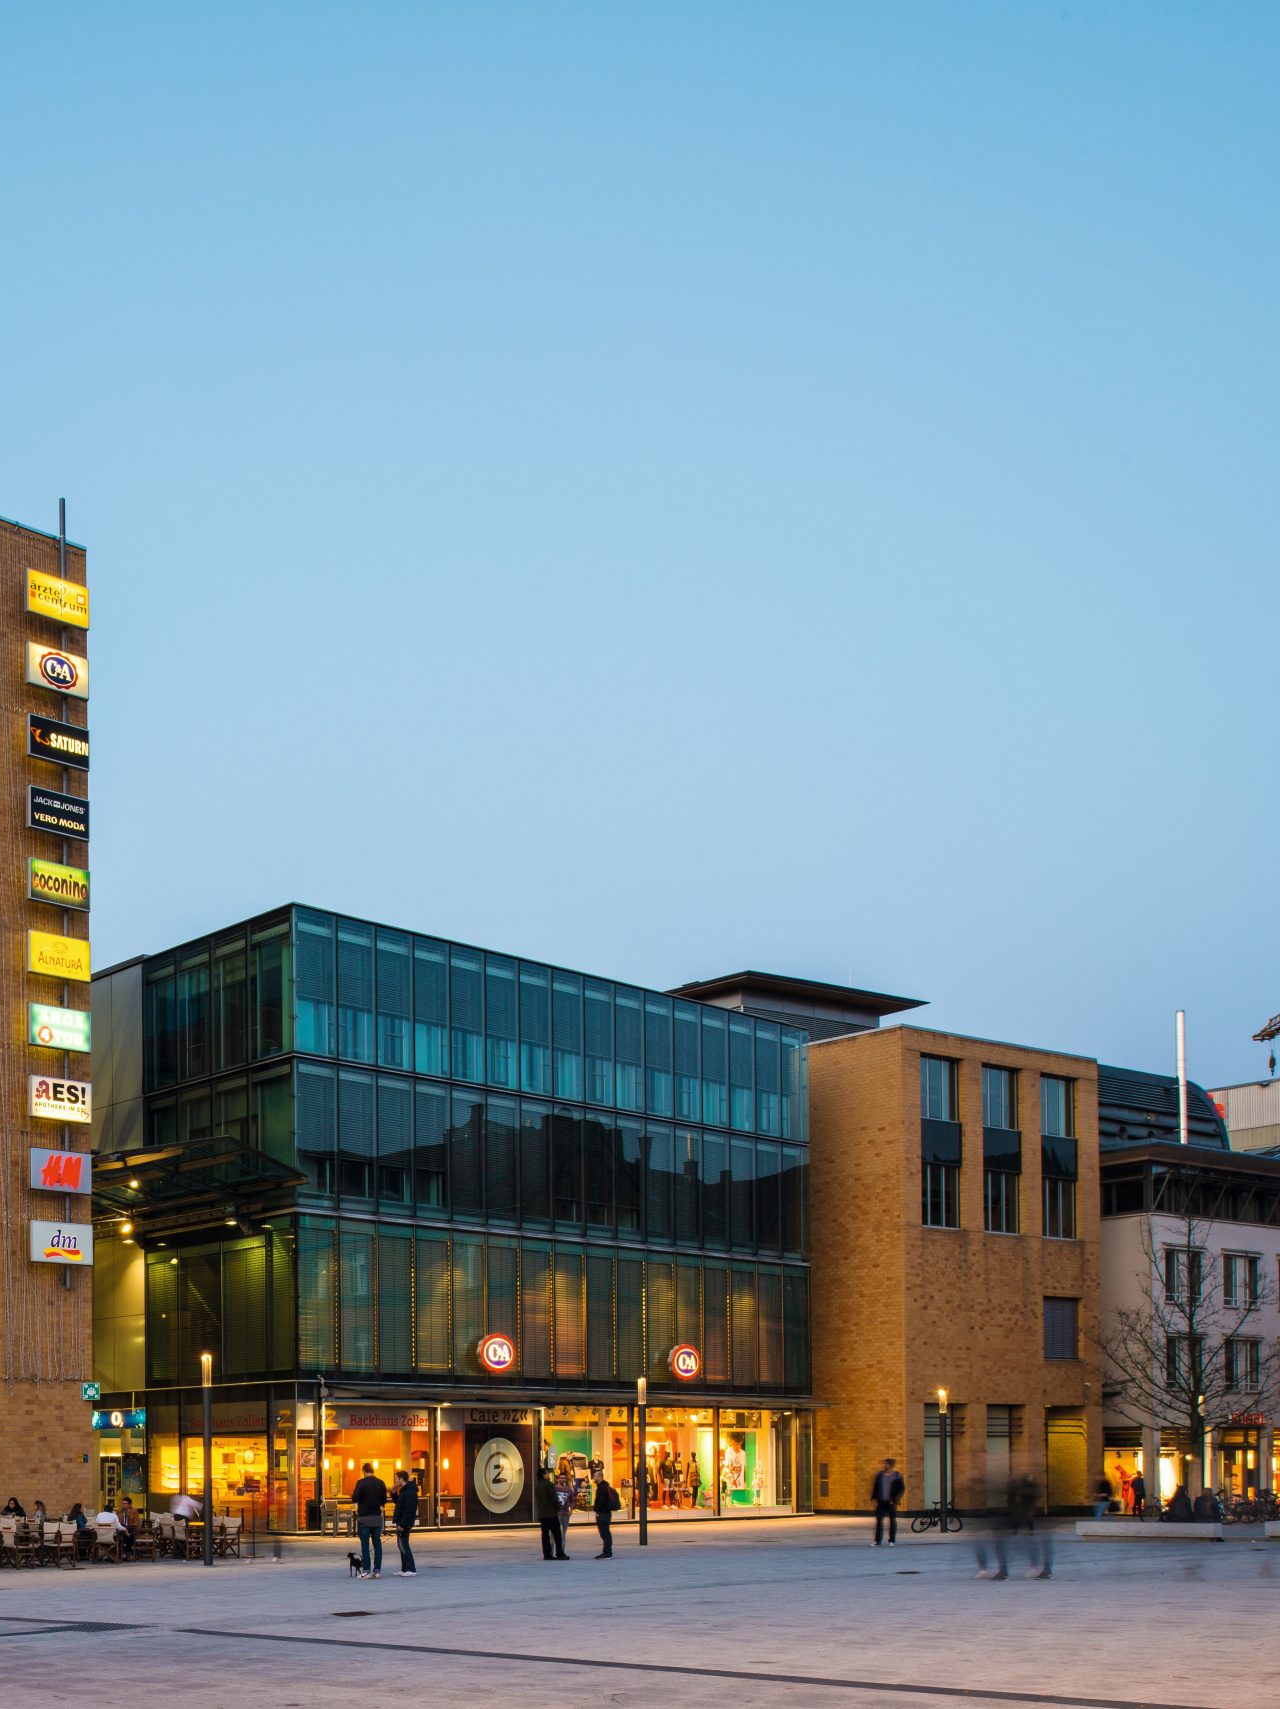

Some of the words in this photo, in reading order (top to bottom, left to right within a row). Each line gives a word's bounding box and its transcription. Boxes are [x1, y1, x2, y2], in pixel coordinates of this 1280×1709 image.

[30, 580, 60, 598] ärzte
[38, 592, 87, 614] centrum
[46, 659, 72, 682] C&A
[49, 733, 88, 756] SATURN
[34, 796, 53, 807] JACK
[61, 803, 84, 814] JONES
[34, 812, 58, 824] VERO
[59, 818, 85, 831] MODA
[32, 872, 88, 900] coconino
[50, 1229, 77, 1249] dm
[350, 1414, 398, 1427] Backhaus
[401, 1414, 430, 1427] Zoller
